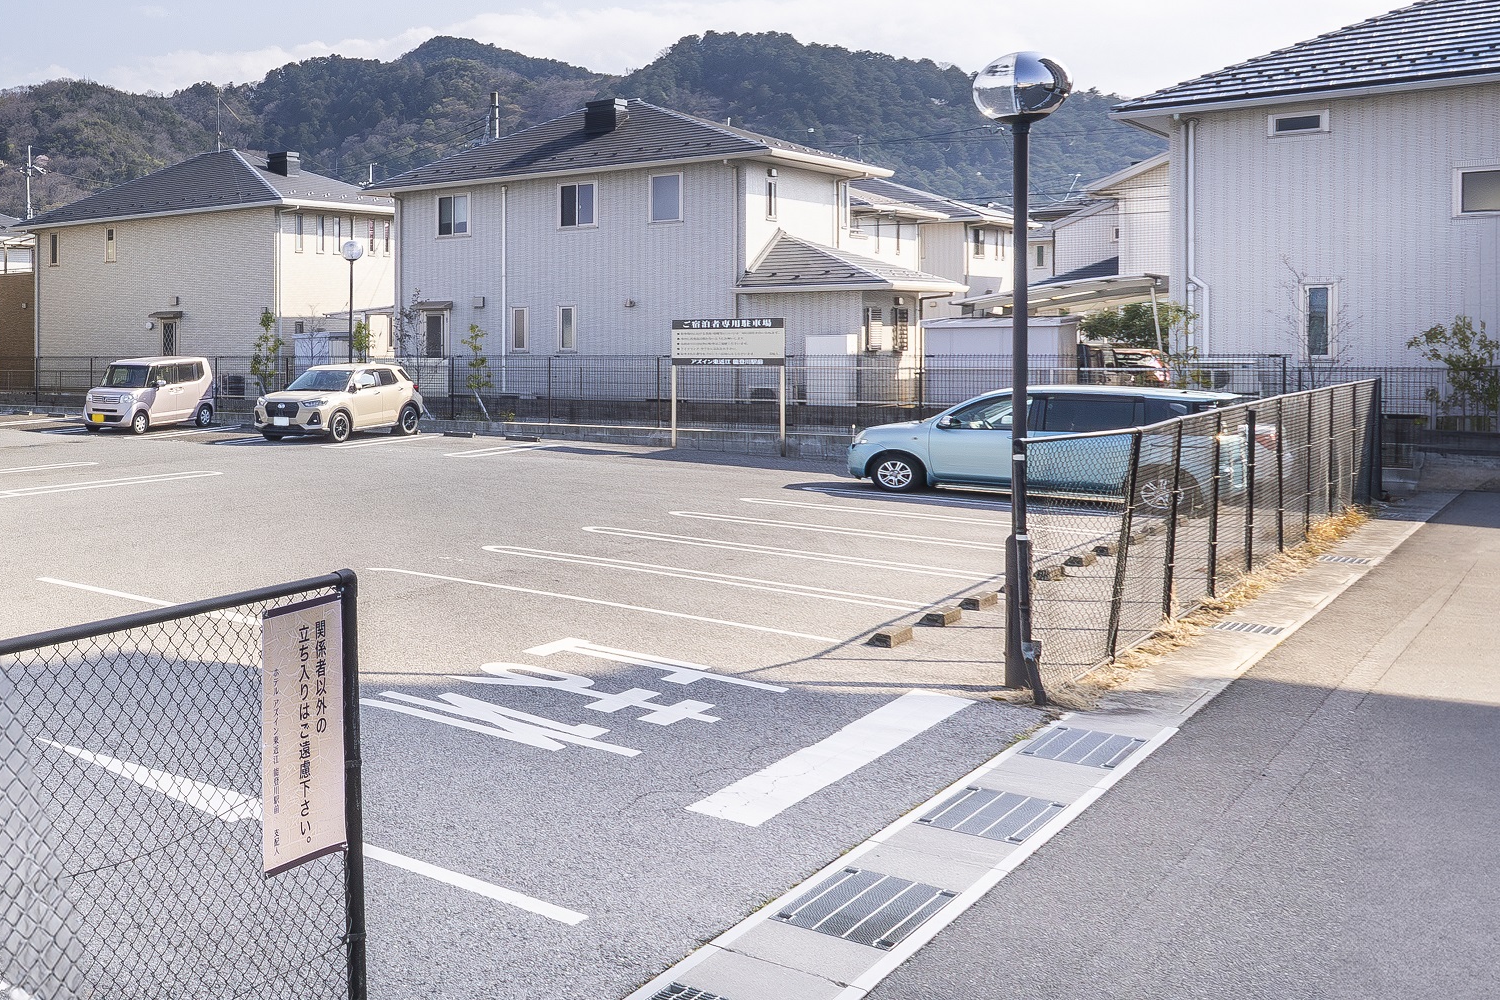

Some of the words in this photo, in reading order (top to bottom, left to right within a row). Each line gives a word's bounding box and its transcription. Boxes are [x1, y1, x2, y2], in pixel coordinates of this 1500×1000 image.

[682, 319, 772, 329] ご宿泊者専用駐車場
[272, 668, 280, 696] ホテル
[298, 624, 312, 844] 立ち入りはご遠慮下さい。
[314, 619, 327, 734] 関係者以外の
[359, 636, 790, 758] 止まれ
